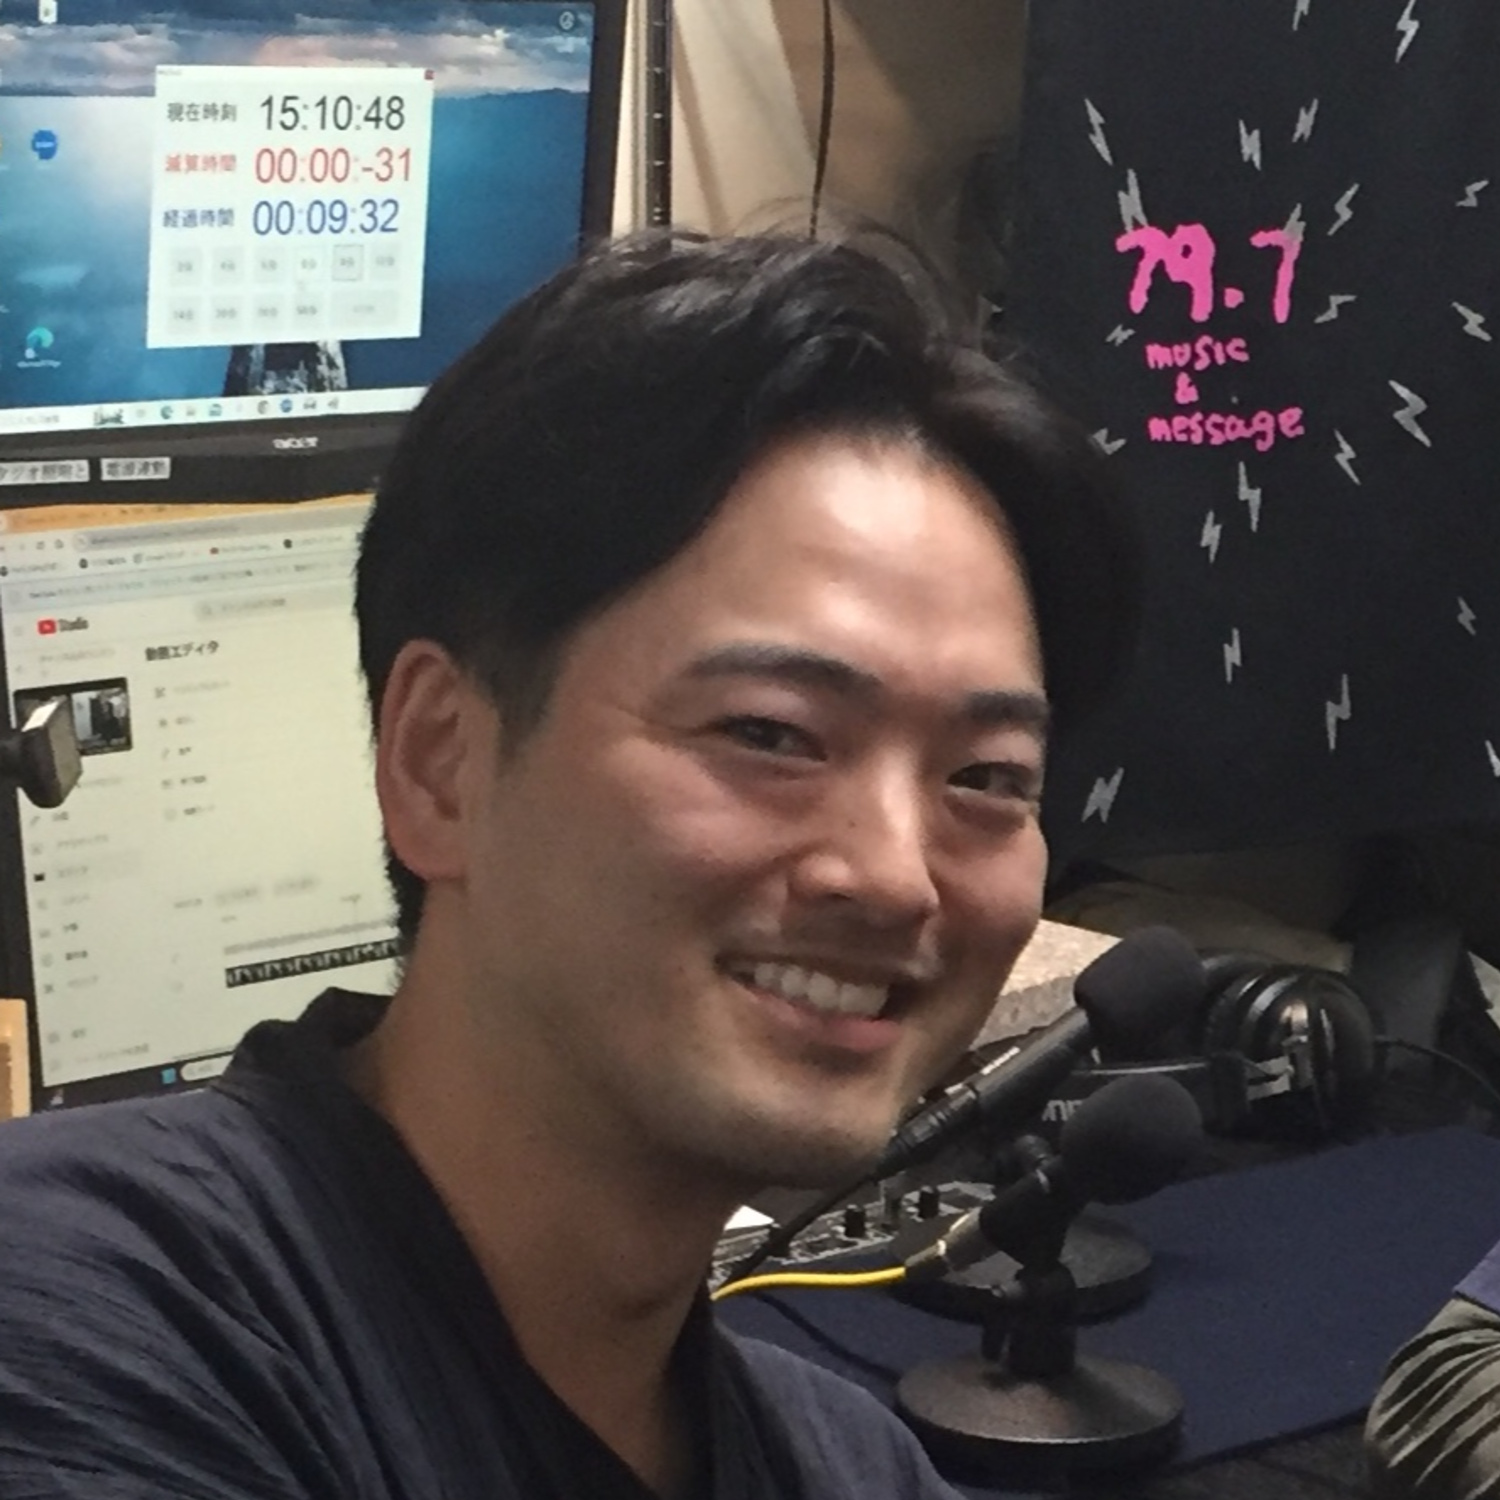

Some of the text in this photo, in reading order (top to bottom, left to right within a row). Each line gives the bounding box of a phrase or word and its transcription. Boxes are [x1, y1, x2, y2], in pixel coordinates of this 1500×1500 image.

[167, 95, 405, 131] 現在時刻 15:10:48
[255, 147, 412, 183] 00:00:-31
[163, 199, 400, 235] 経過時間 00:09:32
[1115, 223, 1302, 323] 79.7
[1146, 335, 1249, 371] music
[1148, 407, 1304, 452] message
